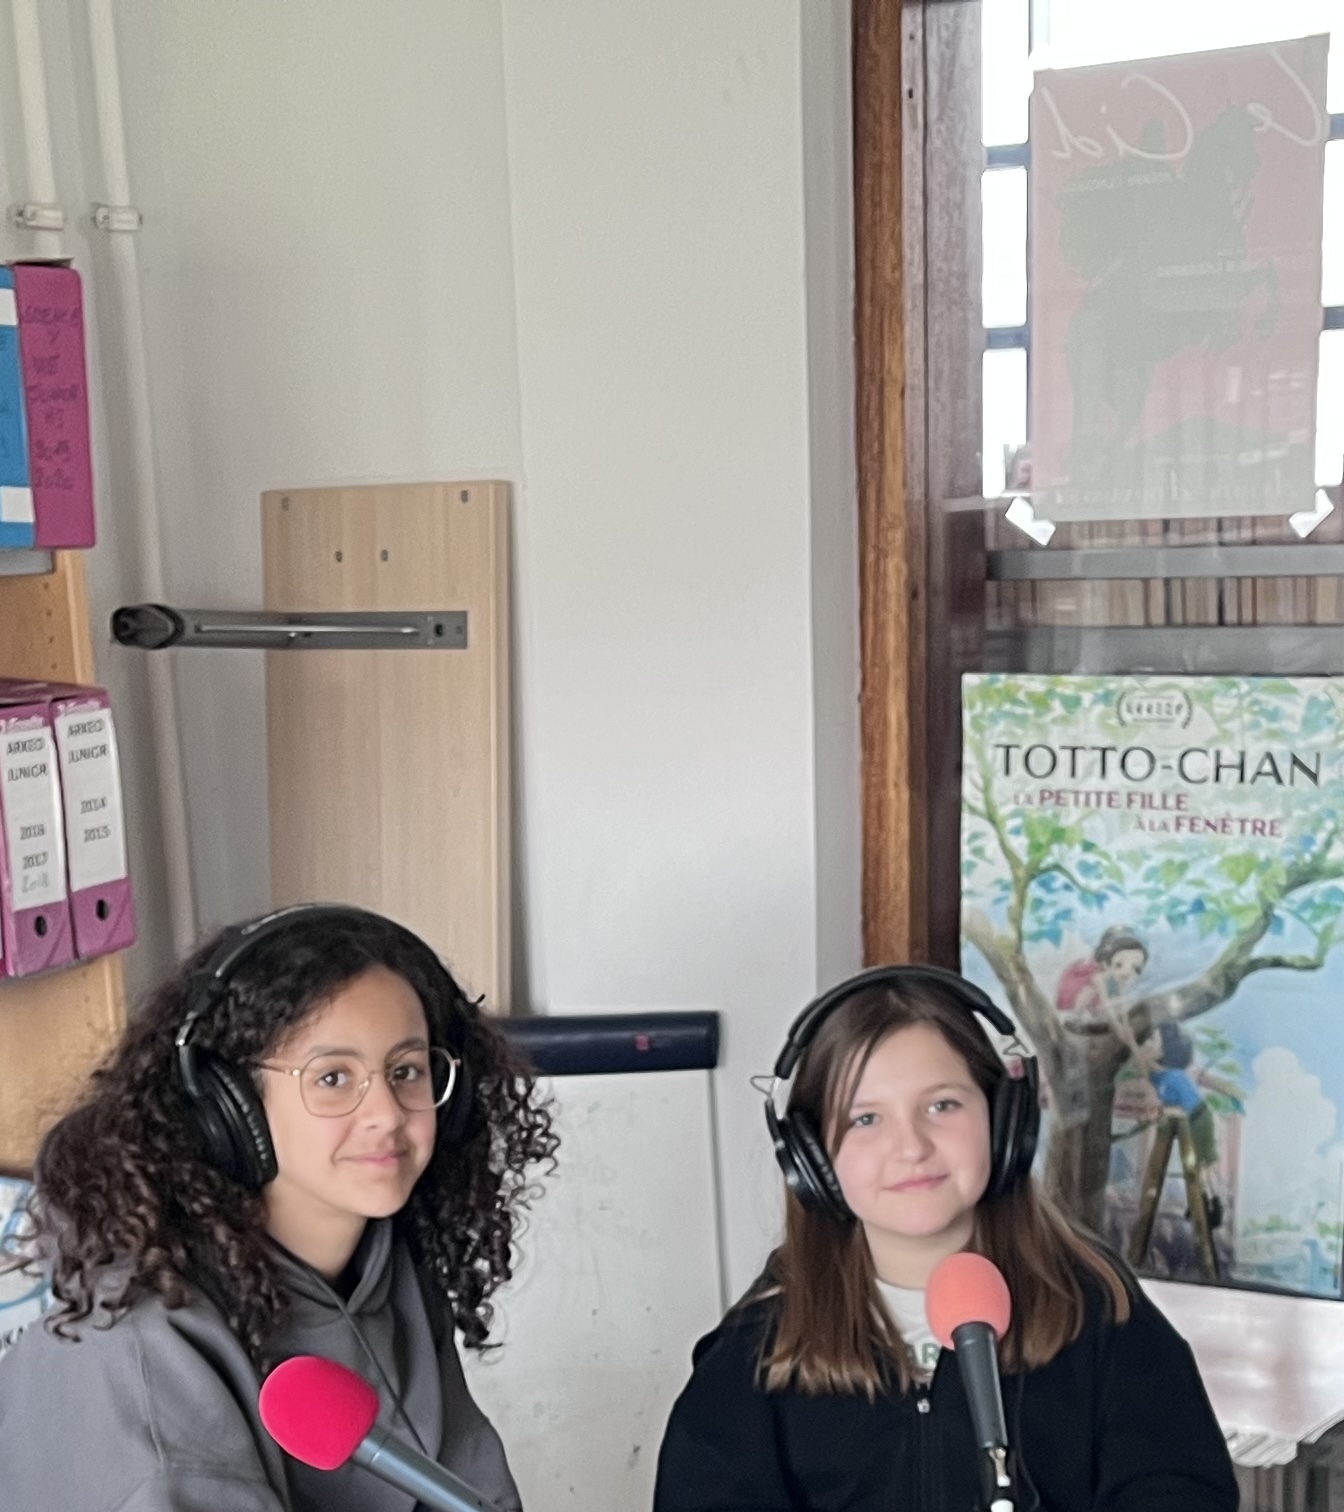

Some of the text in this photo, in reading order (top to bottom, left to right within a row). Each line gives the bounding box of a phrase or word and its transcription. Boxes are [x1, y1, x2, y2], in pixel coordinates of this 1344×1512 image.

[67, 745, 109, 764] JUNIOR
[994, 743, 1322, 788] TOTTO-CHAN
[7, 764, 48, 782] JUNIOR
[1039, 789, 1122, 810] PETITE
[1126, 791, 1190, 812] FILLE
[1174, 812, 1283, 838] FENÊTRE
